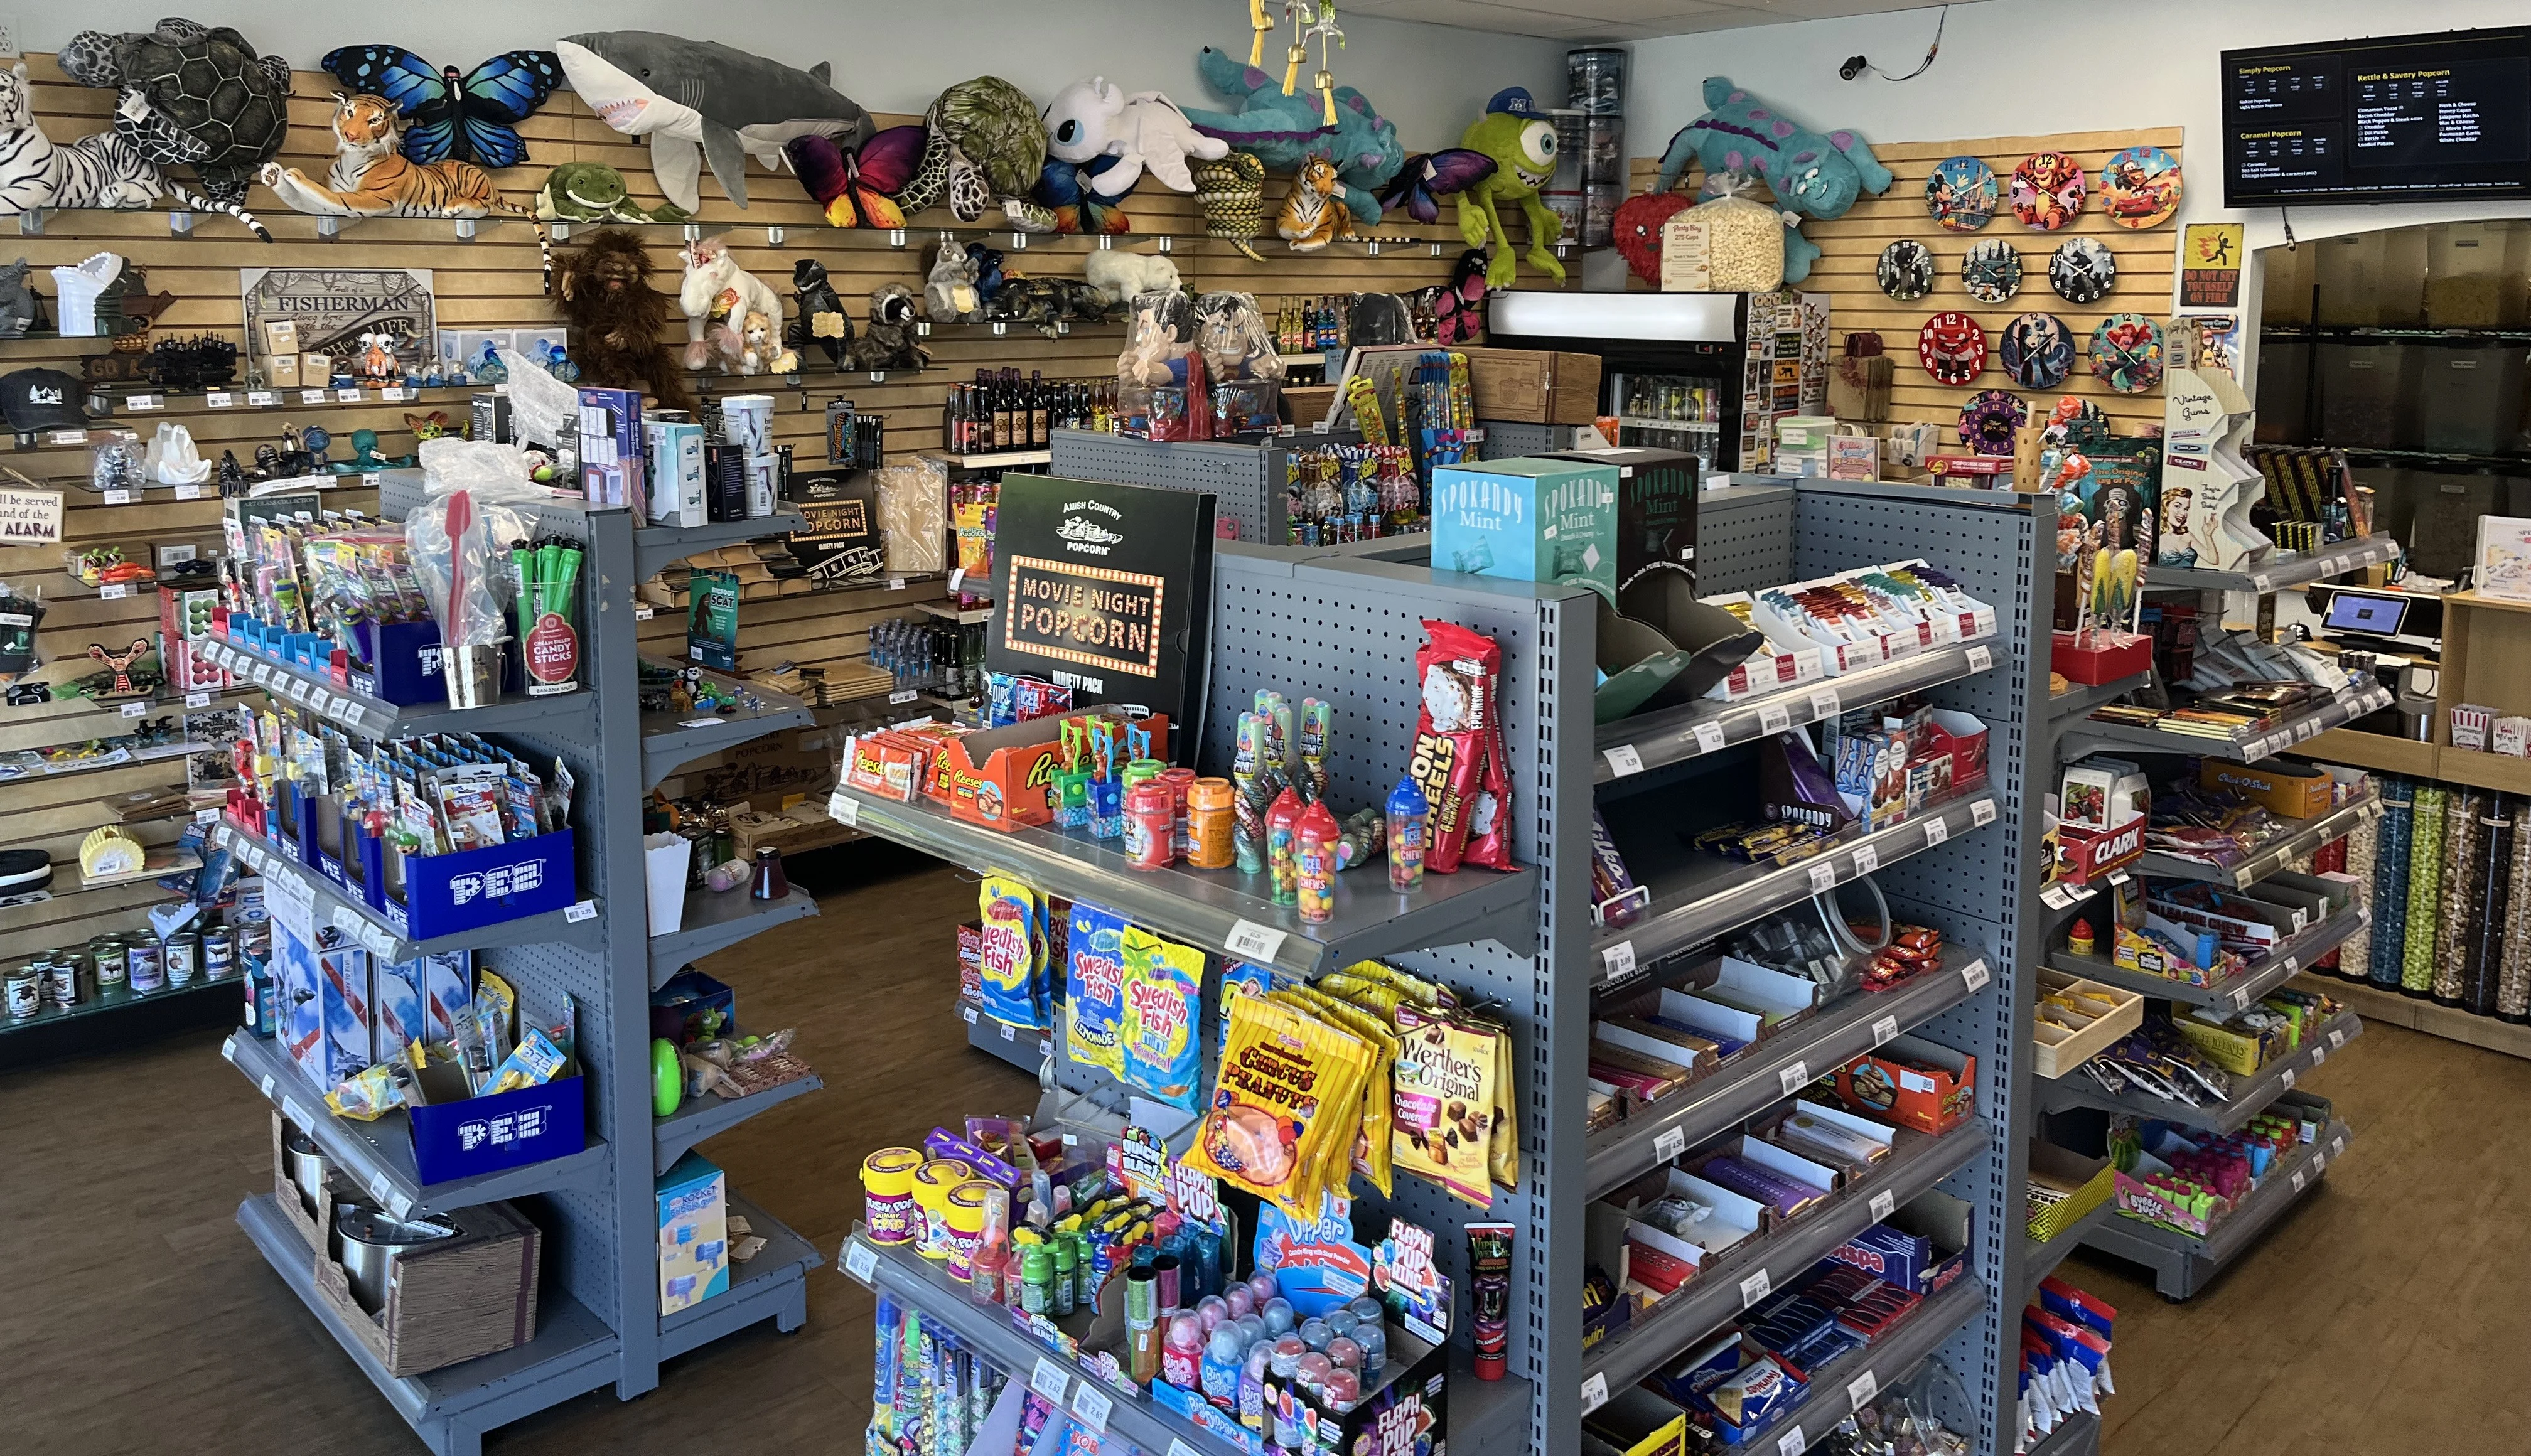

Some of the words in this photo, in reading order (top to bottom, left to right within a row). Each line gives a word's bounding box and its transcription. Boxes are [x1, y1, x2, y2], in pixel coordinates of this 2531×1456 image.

[2418, 70, 2450, 78] Popcorn
[2240, 131, 2270, 139] Caramel
[2184, 270, 2197, 281] DO
[2200, 270, 2217, 281] NOT
[2219, 270, 2238, 281] SET
[2186, 281, 2233, 292] YOURSELF
[278, 297, 410, 311] FISHERMAN
[2190, 292, 2203, 303] ON
[2205, 292, 2228, 303] FIRE
[368, 319, 409, 337] LIFE
[1933, 318, 1942, 328] 11
[1945, 314, 1956, 325] 12
[1962, 319, 1967, 329] 1
[1923, 329, 1934, 340] 10
[1972, 329, 1979, 340] 2
[1922, 343, 1928, 354] 9
[1977, 344, 1983, 355] 3
[1926, 358, 1932, 368] 8
[1974, 360, 1980, 371] 4
[1937, 370, 1943, 380] 7
[1950, 373, 1957, 385] 6
[1964, 370, 1970, 381] 5
[2173, 395, 2213, 406] Vintage
[2182, 407, 2211, 422] Gums
[2094, 468, 2110, 477] The
[2112, 468, 2147, 478] Original
[10, 494, 23, 505] be
[26, 496, 58, 507] served
[1442, 479, 1522, 523] SPOKANDY
[1646, 497, 1679, 515] Mint
[19, 509, 30, 519] of
[33, 510, 49, 520] the
[800, 510, 828, 520] OVIE
[831, 507, 859, 518] NIGHT
[1063, 501, 1086, 513] AMISH
[1088, 500, 1122, 521] COUNTRY
[5, 522, 55, 537] ALARM
[807, 517, 861, 533] OPCORN
[1459, 510, 1502, 531] Mint
[1561, 511, 1595, 530] Mint
[1067, 541, 1107, 555] POPCORN
[711, 594, 734, 608] SCAT
[1023, 577, 1083, 606] MOVIE
[1091, 588, 1151, 617] NIGHT
[1021, 603, 1147, 653] POPCORN
[533, 643, 572, 655] CANDY
[534, 651, 572, 665] STICKS
[1052, 669, 1082, 689] VARIETY
[1082, 675, 1104, 695] PACK
[1471, 685, 1484, 709] INSIDE
[1471, 709, 1483, 730] EPIC
[734, 742, 783, 758] POPCORN
[953, 769, 983, 789] Reese's
[1781, 805, 1832, 827] SPOKANDY
[2095, 825, 2139, 865] CLARK
[1304, 859, 1321, 871] ICEE
[450, 858, 543, 906] PEZ
[1299, 879, 1325, 890] CHEWS
[2208, 917, 2248, 935] CHEW
[982, 926, 1025, 964] wedish
[982, 945, 1013, 978] Fish
[1083, 974, 1114, 1007] Fish
[1129, 979, 1188, 1029] Swedish
[1140, 1003, 1174, 1041] Fish
[1075, 1019, 1114, 1047] LEMONADE
[1142, 1032, 1168, 1055] mini
[1472, 1047, 1490, 1056] STORCK
[520, 1046, 553, 1074] PEZ
[1133, 1041, 1173, 1074] Tropical
[1259, 1041, 1313, 1068] marshmallow
[1400, 1036, 1482, 1083] Werther's
[1239, 1047, 1318, 1093] CIRCUS
[1222, 1062, 1319, 1110] PEANUTS
[1418, 1066, 1480, 1103] Original
[1395, 1093, 1437, 1113] Chocolate
[1396, 1108, 1432, 1124] Covered
[458, 1106, 548, 1151] PEZ
[1122, 1137, 1161, 1165] QUICK
[1122, 1157, 1161, 1180] BLAST
[1175, 1165, 1213, 1196] FLASH
[682, 1185, 717, 1203] ROCKET
[701, 1195, 717, 1207] gun
[1176, 1183, 1215, 1221] POP
[866, 1198, 892, 1213] PUSH
[893, 1198, 915, 1212] POP
[2130, 1194, 2163, 1215] BUBBLE
[2137, 1203, 2155, 1218] JUG
[1287, 1214, 1345, 1248] Dipper
[1392, 1218, 1431, 1255] FLASH
[1394, 1239, 1428, 1275] POP
[1390, 1261, 1424, 1295] RING
[1164, 1351, 1181, 1371] Big
[1205, 1366, 1222, 1383] Big
[1048, 1380, 1061, 1395] 2.62
[1202, 1379, 1235, 1396] Dipper
[1090, 1406, 1104, 1421] 2.62
[1189, 1396, 1206, 1419] Big
[1378, 1394, 1421, 1433] FLASH
[1206, 1406, 1238, 1438] Dipper
[1069, 1429, 1099, 1455] BOB
[1382, 1414, 1417, 1452] POP
